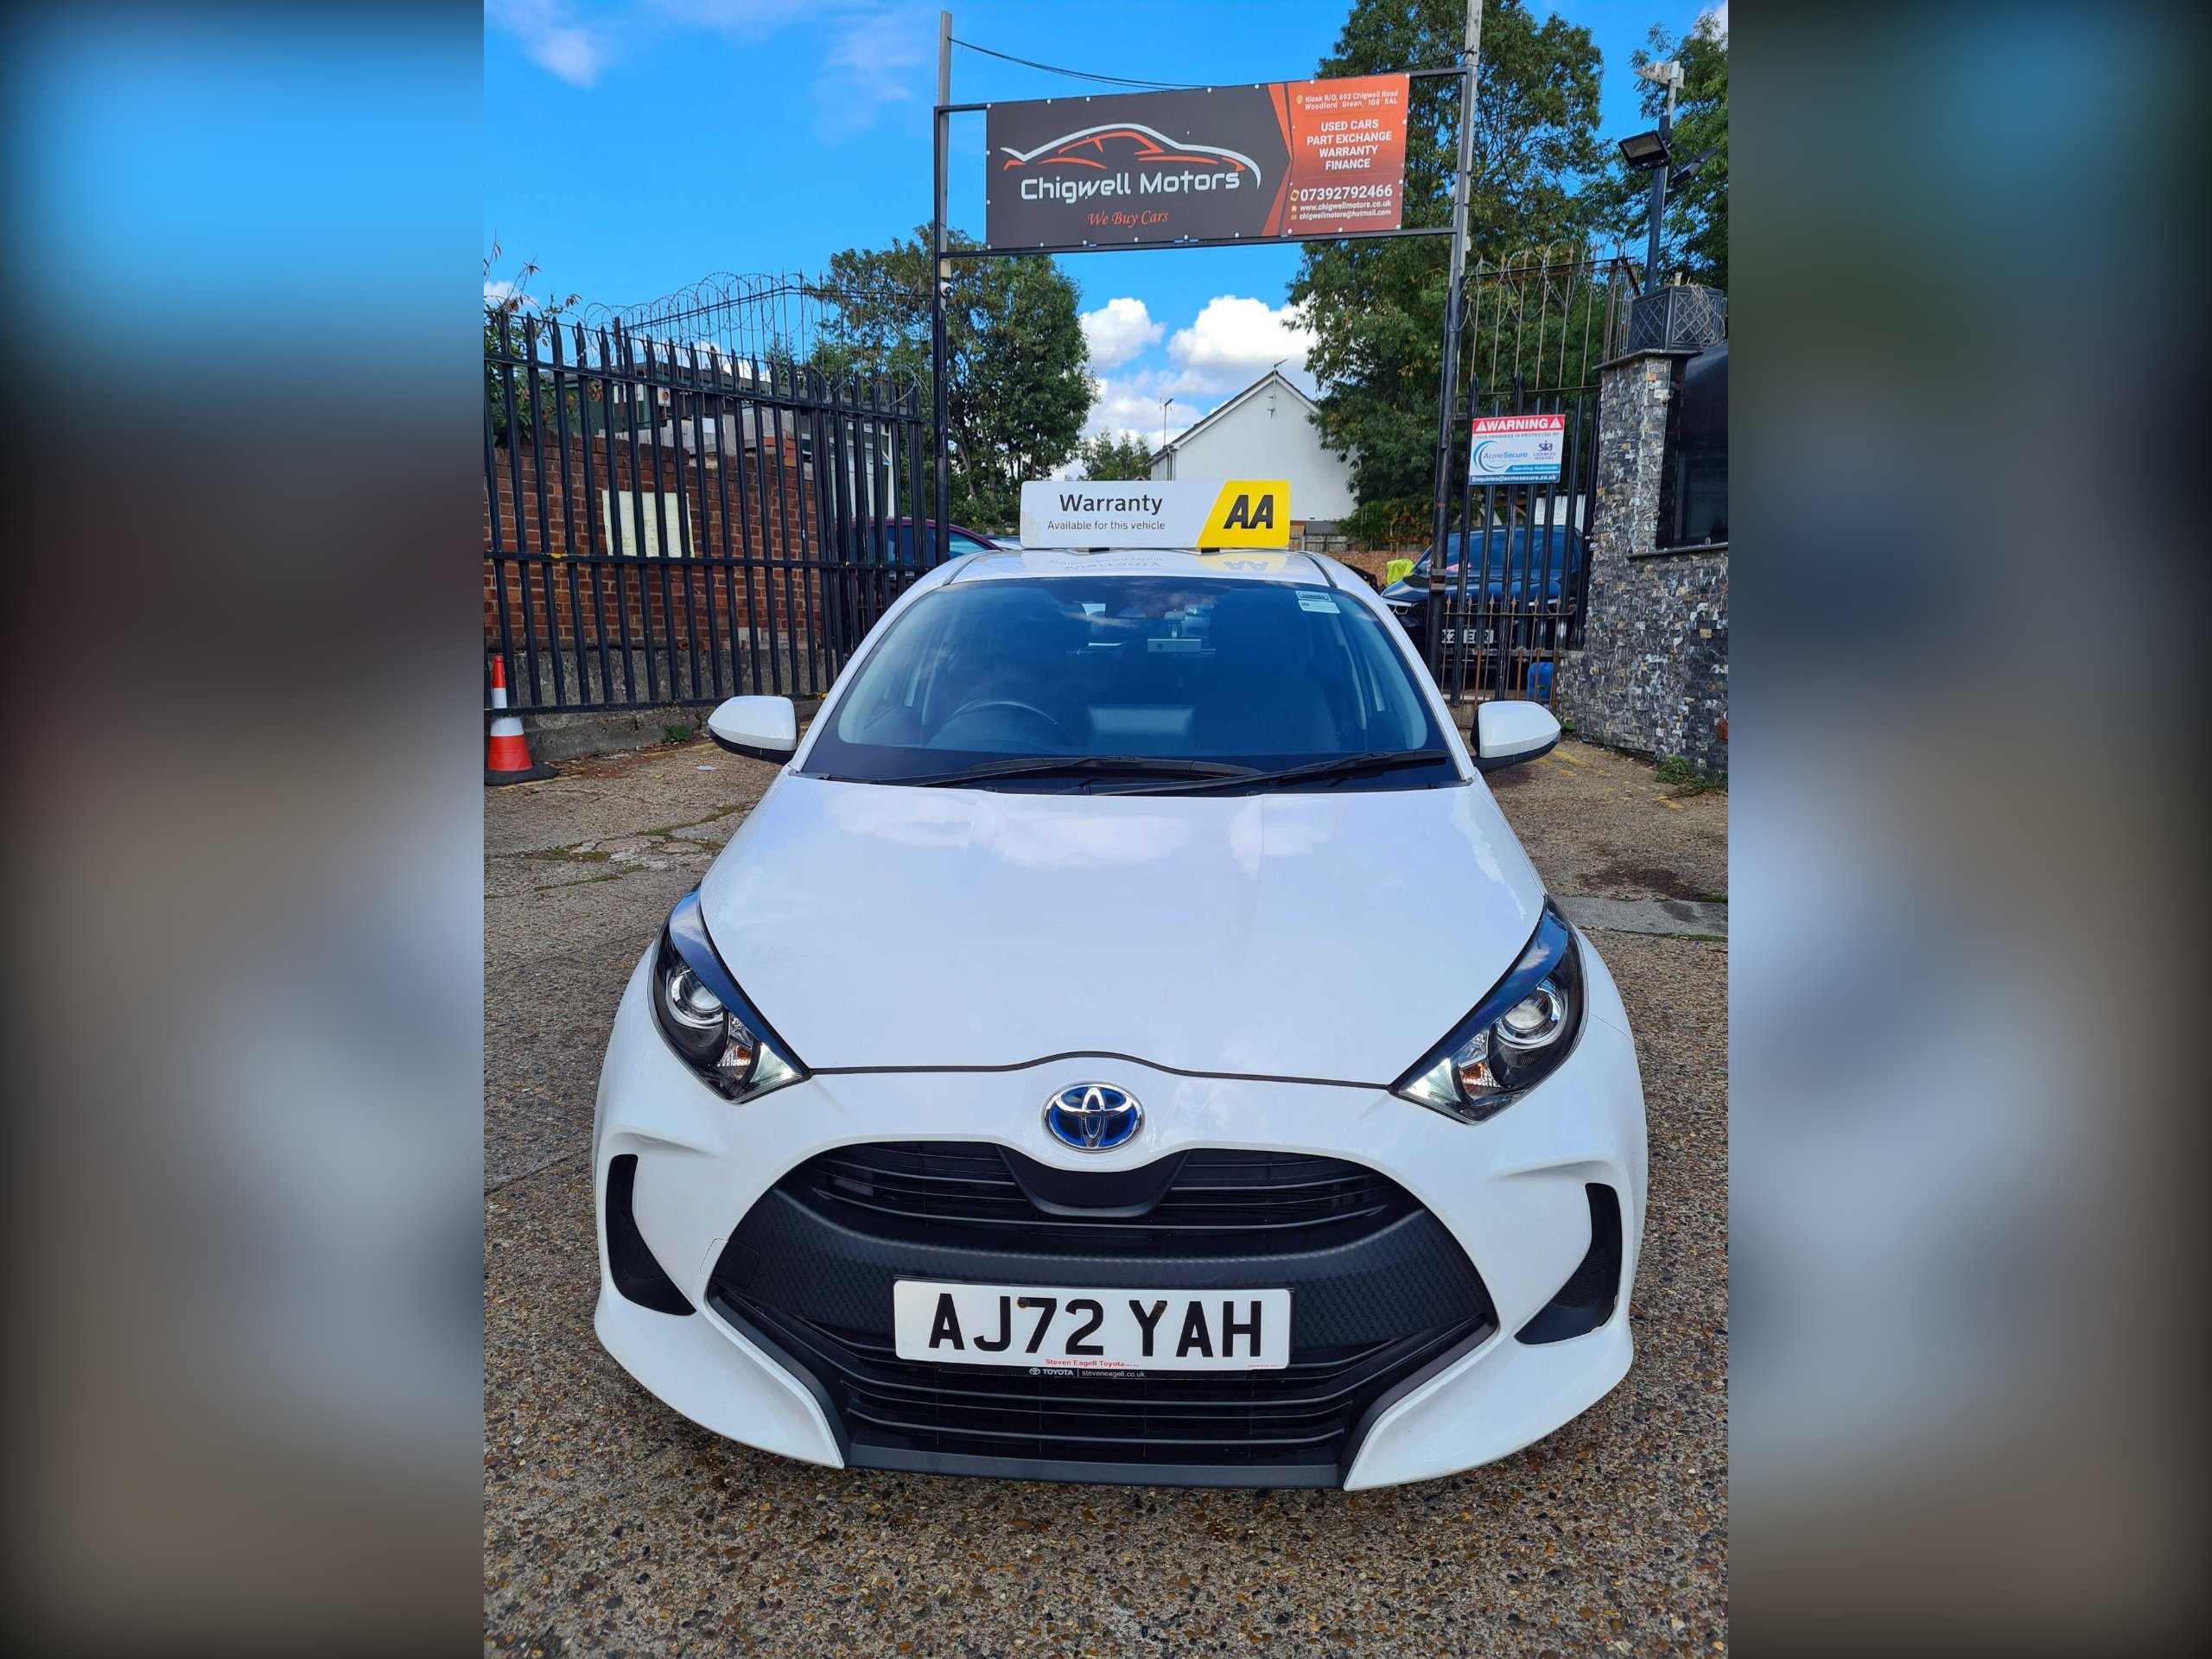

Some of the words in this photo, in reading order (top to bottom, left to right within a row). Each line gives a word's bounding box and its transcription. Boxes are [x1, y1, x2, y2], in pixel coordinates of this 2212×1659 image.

[1353, 91, 1381, 101] Chigwell
[1305, 100, 1338, 111] Woodford
[1342, 100, 1363, 109] Green,
[1320, 121, 1347, 132] USED
[1351, 119, 1379, 130] CARS
[1306, 135, 1333, 146] PART
[1336, 131, 1392, 144] EXCHANGE
[1319, 144, 1378, 157] WARRANTY
[1325, 158, 1371, 170] FINANCE
[1020, 172, 1132, 205] Chigwell
[1140, 170, 1240, 194] Motors
[1300, 184, 1393, 201] 07392792466
[1300, 200, 1392, 212] www.chigwellmotors.co.uk
[1087, 212, 1109, 226] We
[1111, 211, 1139, 228] Buy
[1141, 209, 1169, 224] Cars
[1299, 209, 1391, 220] chigwellmotors@hotmail.com
[1486, 418, 1548, 431] WARNING
[1059, 493, 1164, 516] Warranty
[1223, 494, 1274, 530] AA
[1047, 520, 1092, 530] Available
[1094, 520, 1108, 530] for
[1110, 520, 1128, 530] this
[1130, 520, 1166, 530] vehicle
[928, 1293, 1104, 1356] AJ72
[1128, 1300, 1262, 1357] YAH
